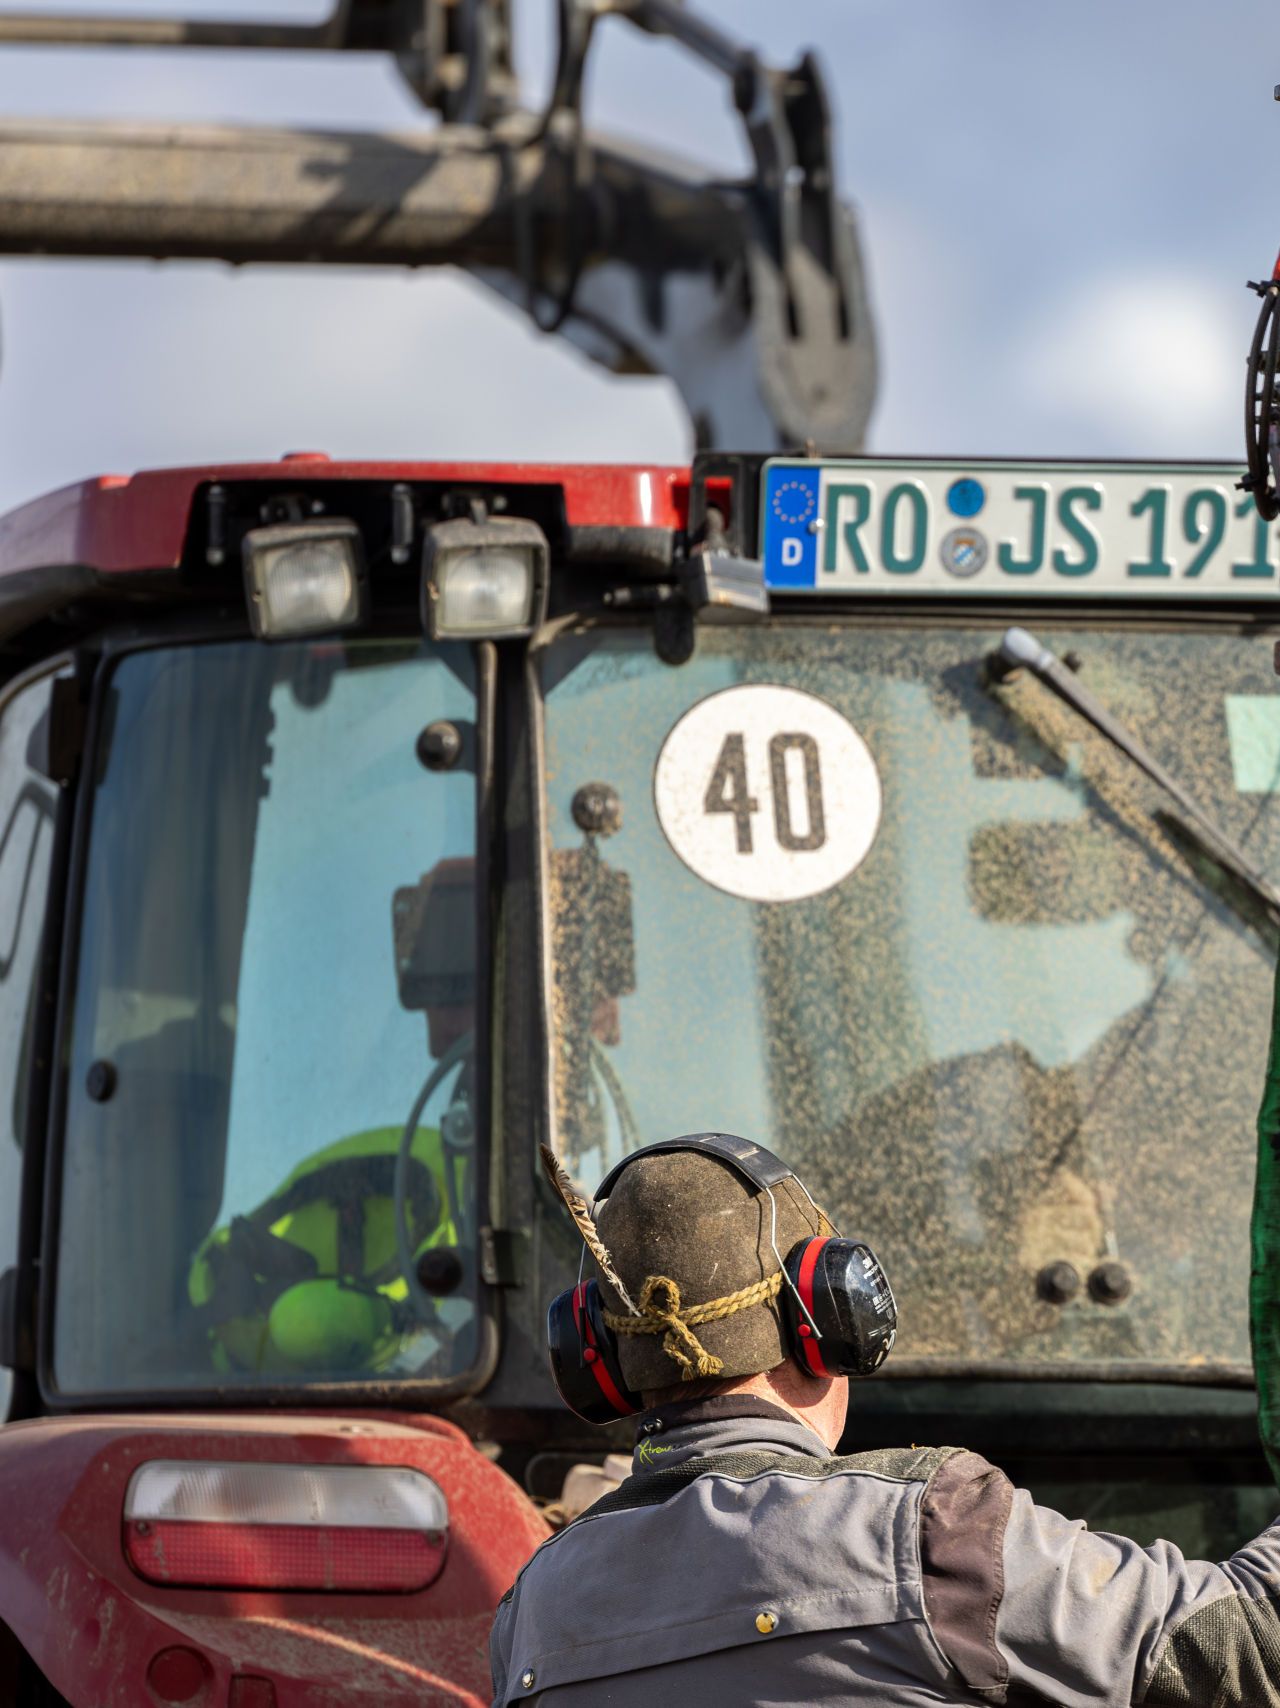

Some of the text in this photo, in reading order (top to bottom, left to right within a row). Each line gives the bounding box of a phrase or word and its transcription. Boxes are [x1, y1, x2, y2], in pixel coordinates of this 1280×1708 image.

[781, 537, 803, 566] D
[823, 481, 1276, 577] RO JS 191
[703, 732, 827, 855] 40
